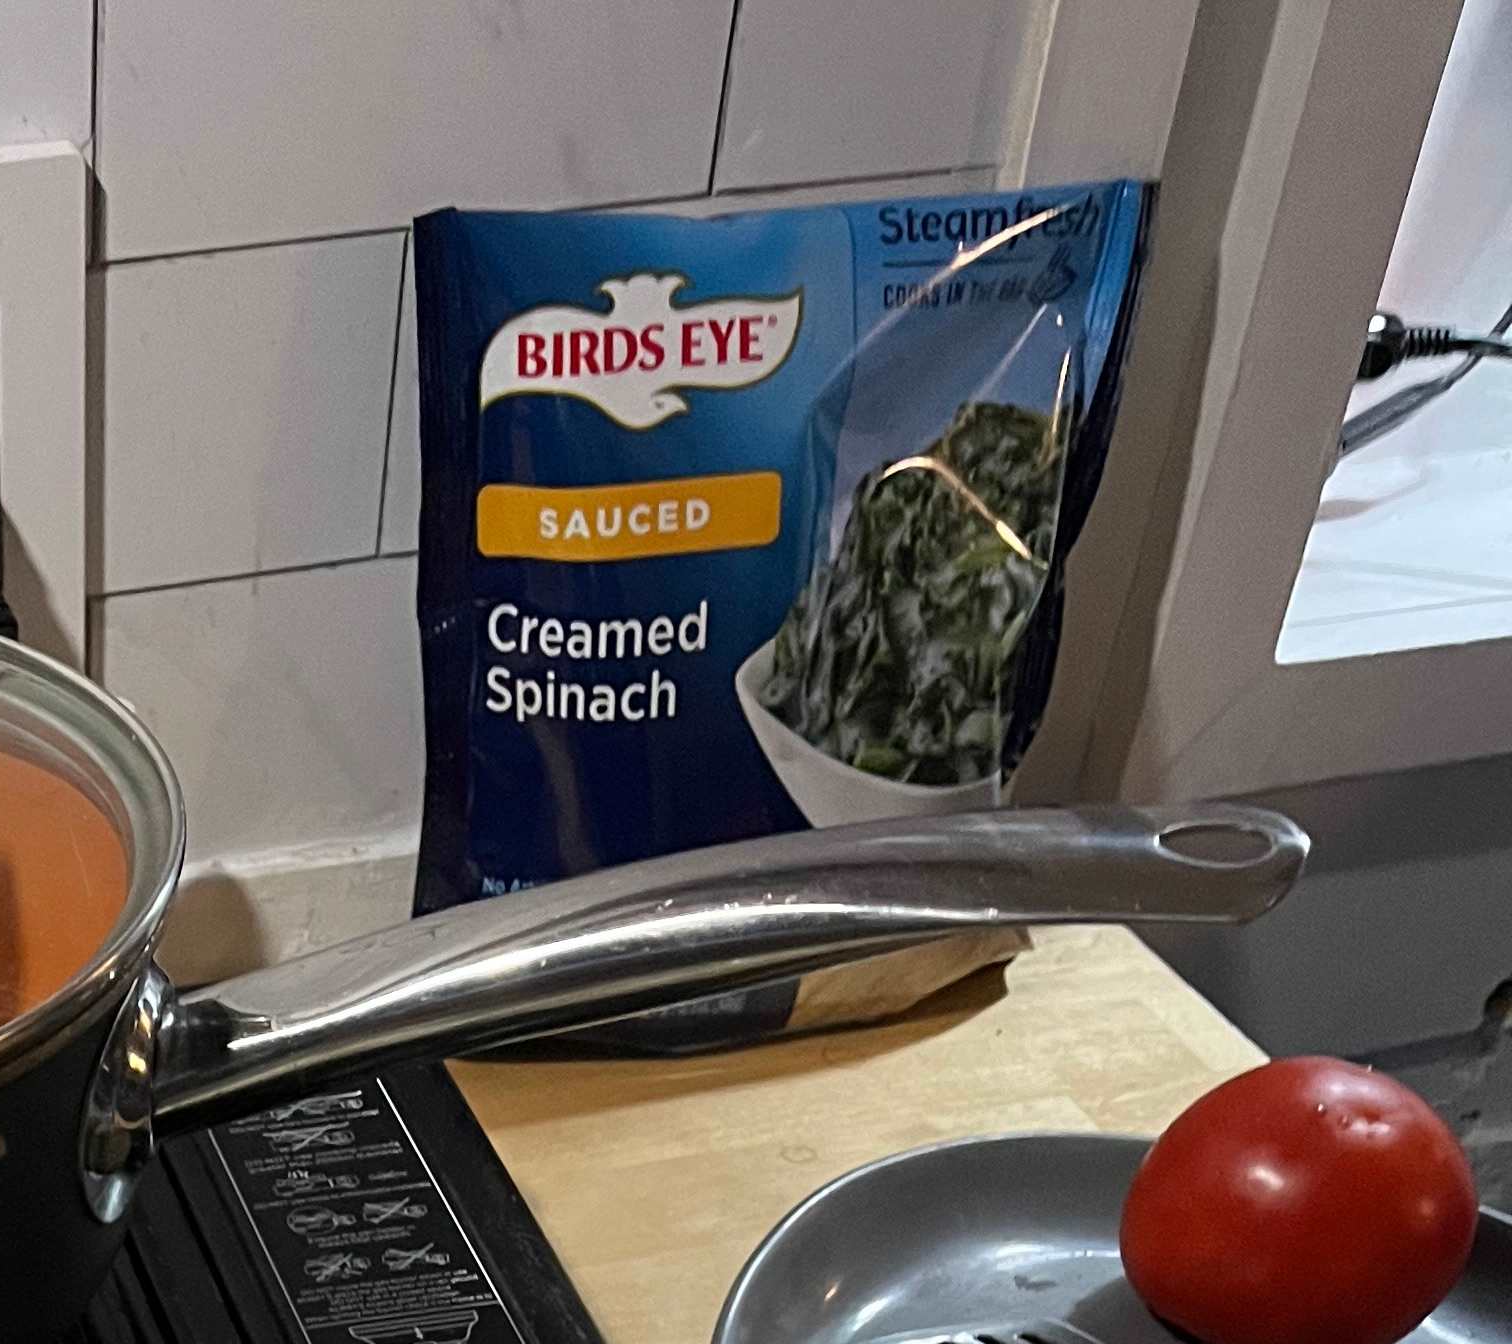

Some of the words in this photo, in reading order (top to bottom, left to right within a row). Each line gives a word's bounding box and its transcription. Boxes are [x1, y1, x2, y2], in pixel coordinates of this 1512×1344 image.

[517, 323, 665, 378] BIRDS
[681, 314, 764, 367] EYE
[539, 498, 710, 540] SAUCED
[488, 599, 708, 659] Creamed
[486, 669, 677, 722] Spinach
